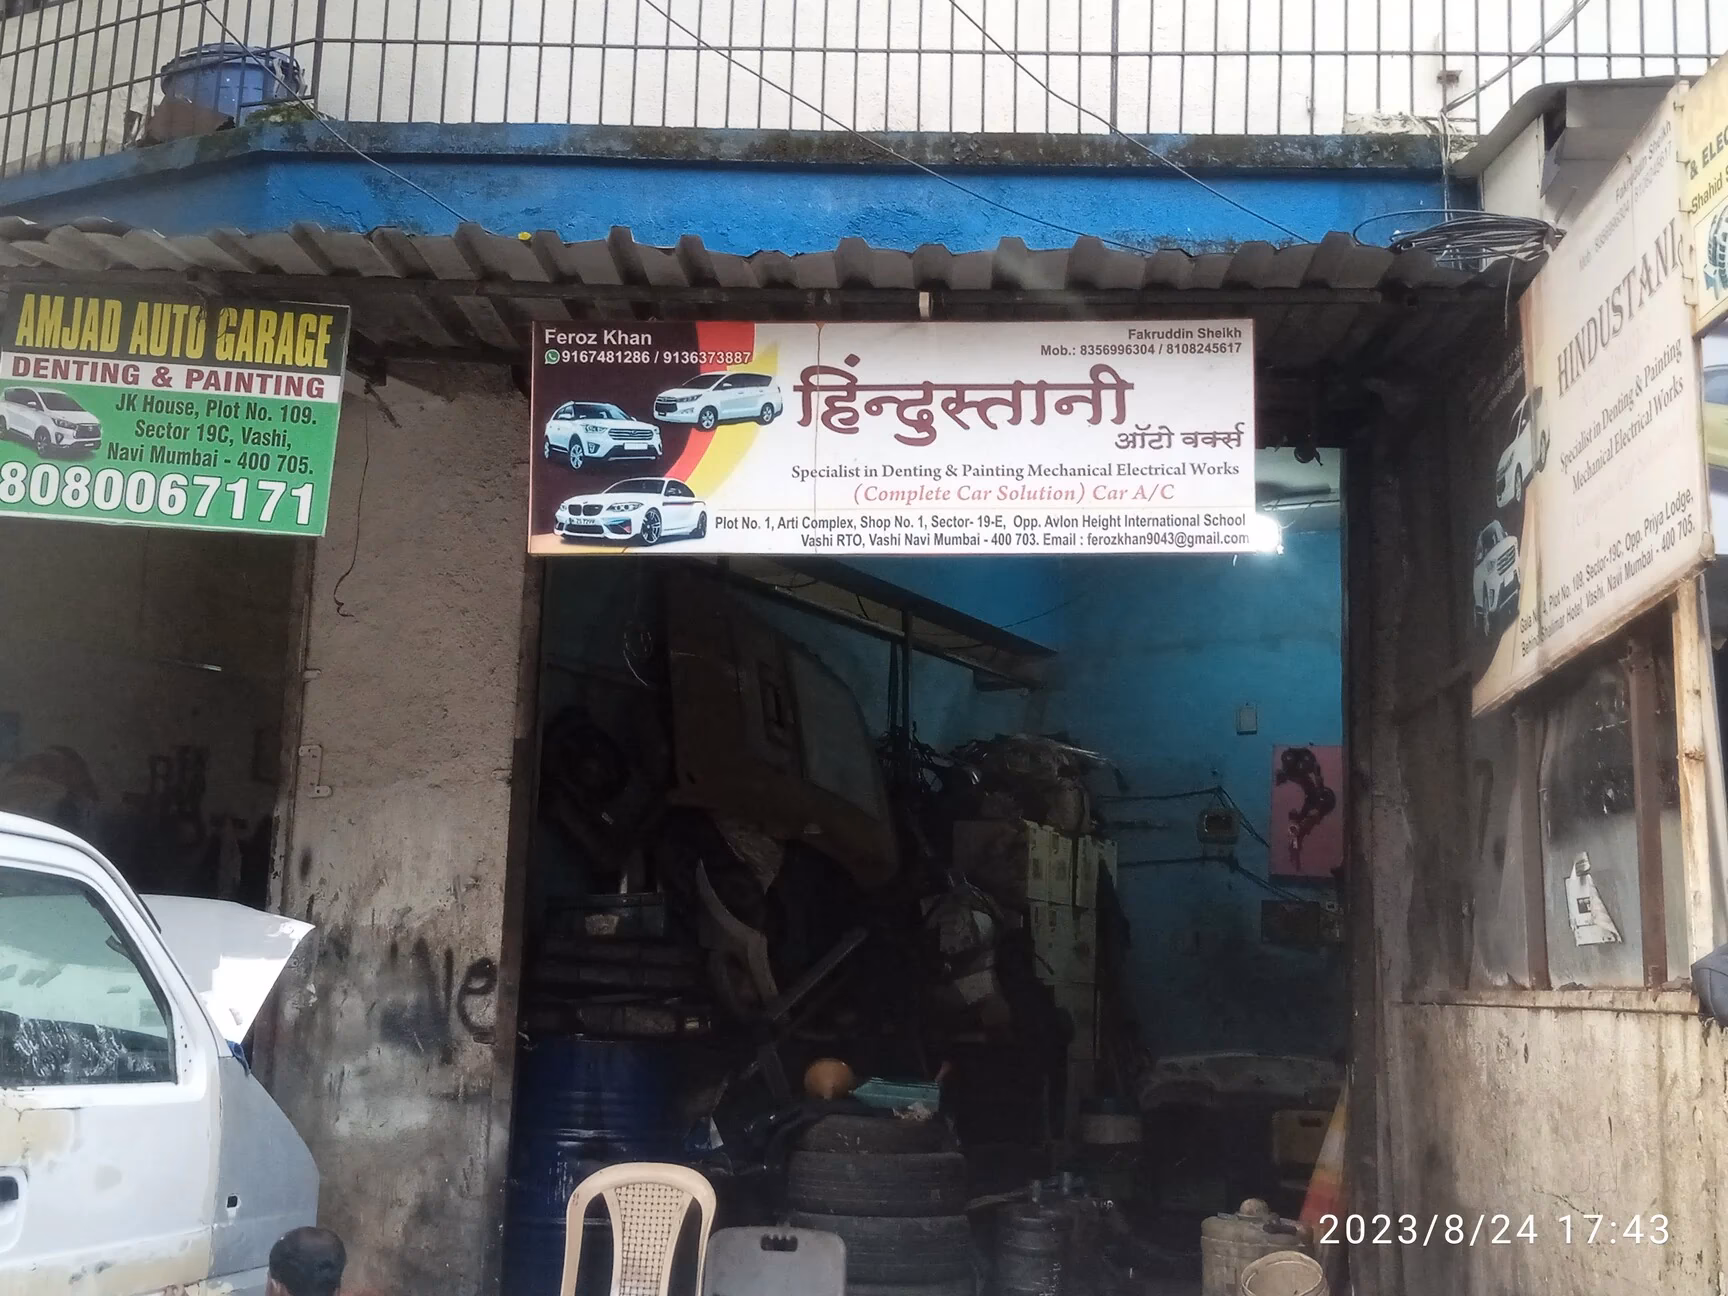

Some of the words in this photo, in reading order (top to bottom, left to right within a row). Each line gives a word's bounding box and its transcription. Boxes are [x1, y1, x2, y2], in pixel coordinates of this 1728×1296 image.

[1690, 160, 1698, 180] &
[1691, 172, 1722, 214] Shahid
[1557, 217, 1677, 397] HINDUSTANI
[14, 293, 122, 353] AMJAD
[129, 301, 207, 359] AUTO
[216, 307, 333, 368] GARAGE
[544, 330, 597, 345] Feroz
[603, 330, 652, 346] Khan
[1128, 328, 1193, 340] Fakruddin
[1197, 328, 1242, 338] Sheikh
[562, 350, 650, 364] 9167481286
[663, 352, 751, 364] 9136373887
[1041, 345, 1076, 356] Mob.:
[1080, 344, 1155, 355] 8356996304
[1158, 344, 1162, 354] /
[1166, 343, 1241, 353] 8108245617
[12, 356, 140, 386] DENTING
[151, 366, 173, 388] &
[185, 369, 325, 399] PAINTING
[116, 394, 136, 413] JK
[143, 397, 199, 418] House,
[206, 399, 240, 419] Plot
[246, 402, 272, 421] No.
[280, 405, 317, 424] 109.
[1560, 431, 1592, 475] Specialist
[1593, 417, 1600, 438] in
[1602, 390, 1633, 429] Denting
[1635, 375, 1642, 397] &
[1644, 339, 1681, 387] Painting
[135, 420, 190, 440] Sector
[197, 424, 234, 446] 19C,
[242, 427, 291, 450] Vashi,
[1115, 424, 1175, 449] ऑटो
[1181, 422, 1245, 449] वर्क्स
[1573, 441, 1612, 494] Mechanical
[1614, 402, 1651, 455] Electrical
[1653, 377, 1683, 416] Works
[108, 443, 144, 463] Navi
[150, 446, 218, 467] Mumbai
[237, 452, 271, 471] 400
[277, 456, 313, 475] 705.
[792, 465, 860, 482] Specialist
[864, 466, 878, 477] in
[882, 464, 941, 481] Denting
[946, 464, 958, 477] &
[962, 464, 1024, 481] Painting
[1027, 463, 1112, 477] Mechanical
[1117, 463, 1186, 476] Electrical
[1191, 462, 1239, 475] Works
[0, 461, 315, 527] 8080067171
[854, 483, 951, 505] (Complete
[957, 486, 992, 500] Car
[997, 482, 1085, 504] Solution)
[1093, 485, 1128, 500] Car
[1132, 484, 1175, 502] A/C
[716, 517, 738, 529] Plot
[742, 517, 761, 529] No.
[765, 517, 774, 531] 1,
[778, 516, 798, 529] Arti
[802, 516, 857, 531] Complex,
[860, 516, 891, 530] Shop
[894, 516, 914, 528] No.
[918, 516, 927, 530] 1,
[931, 515, 974, 528] Sector-
[977, 515, 1006, 529] 19-E,
[1014, 515, 1041, 530] Opp.
[1045, 515, 1078, 527] Avlon
[1082, 514, 1121, 530] Height
[1125, 514, 1200, 527] International
[1204, 514, 1246, 526] School
[801, 534, 833, 546] Vashi
[837, 534, 865, 548] RTO,
[869, 534, 900, 546] Vashi
[905, 533, 930, 546] Navi
[934, 533, 980, 545] Mumbai
[991, 533, 1011, 545] 400
[1016, 533, 1039, 545] 703.
[1043, 533, 1076, 545] Email
[1087, 531, 1249, 548] ferozkhan9043@gmail.com
[1548, 588, 1560, 611] Plot
[1561, 581, 1571, 600] No.
[1586, 540, 1623, 582] Sector-19C,
[1625, 529, 1642, 549] Opp.
[1643, 511, 1663, 535] Priya
[1665, 488, 1693, 520] Lodge,
[1566, 599, 1583, 624] Hotel,
[1586, 585, 1605, 608] Vashi,
[1607, 572, 1622, 592] Navi
[1624, 551, 1653, 580] Mumbai
[1661, 530, 1675, 553] 400
[1678, 511, 1695, 541] 705.
